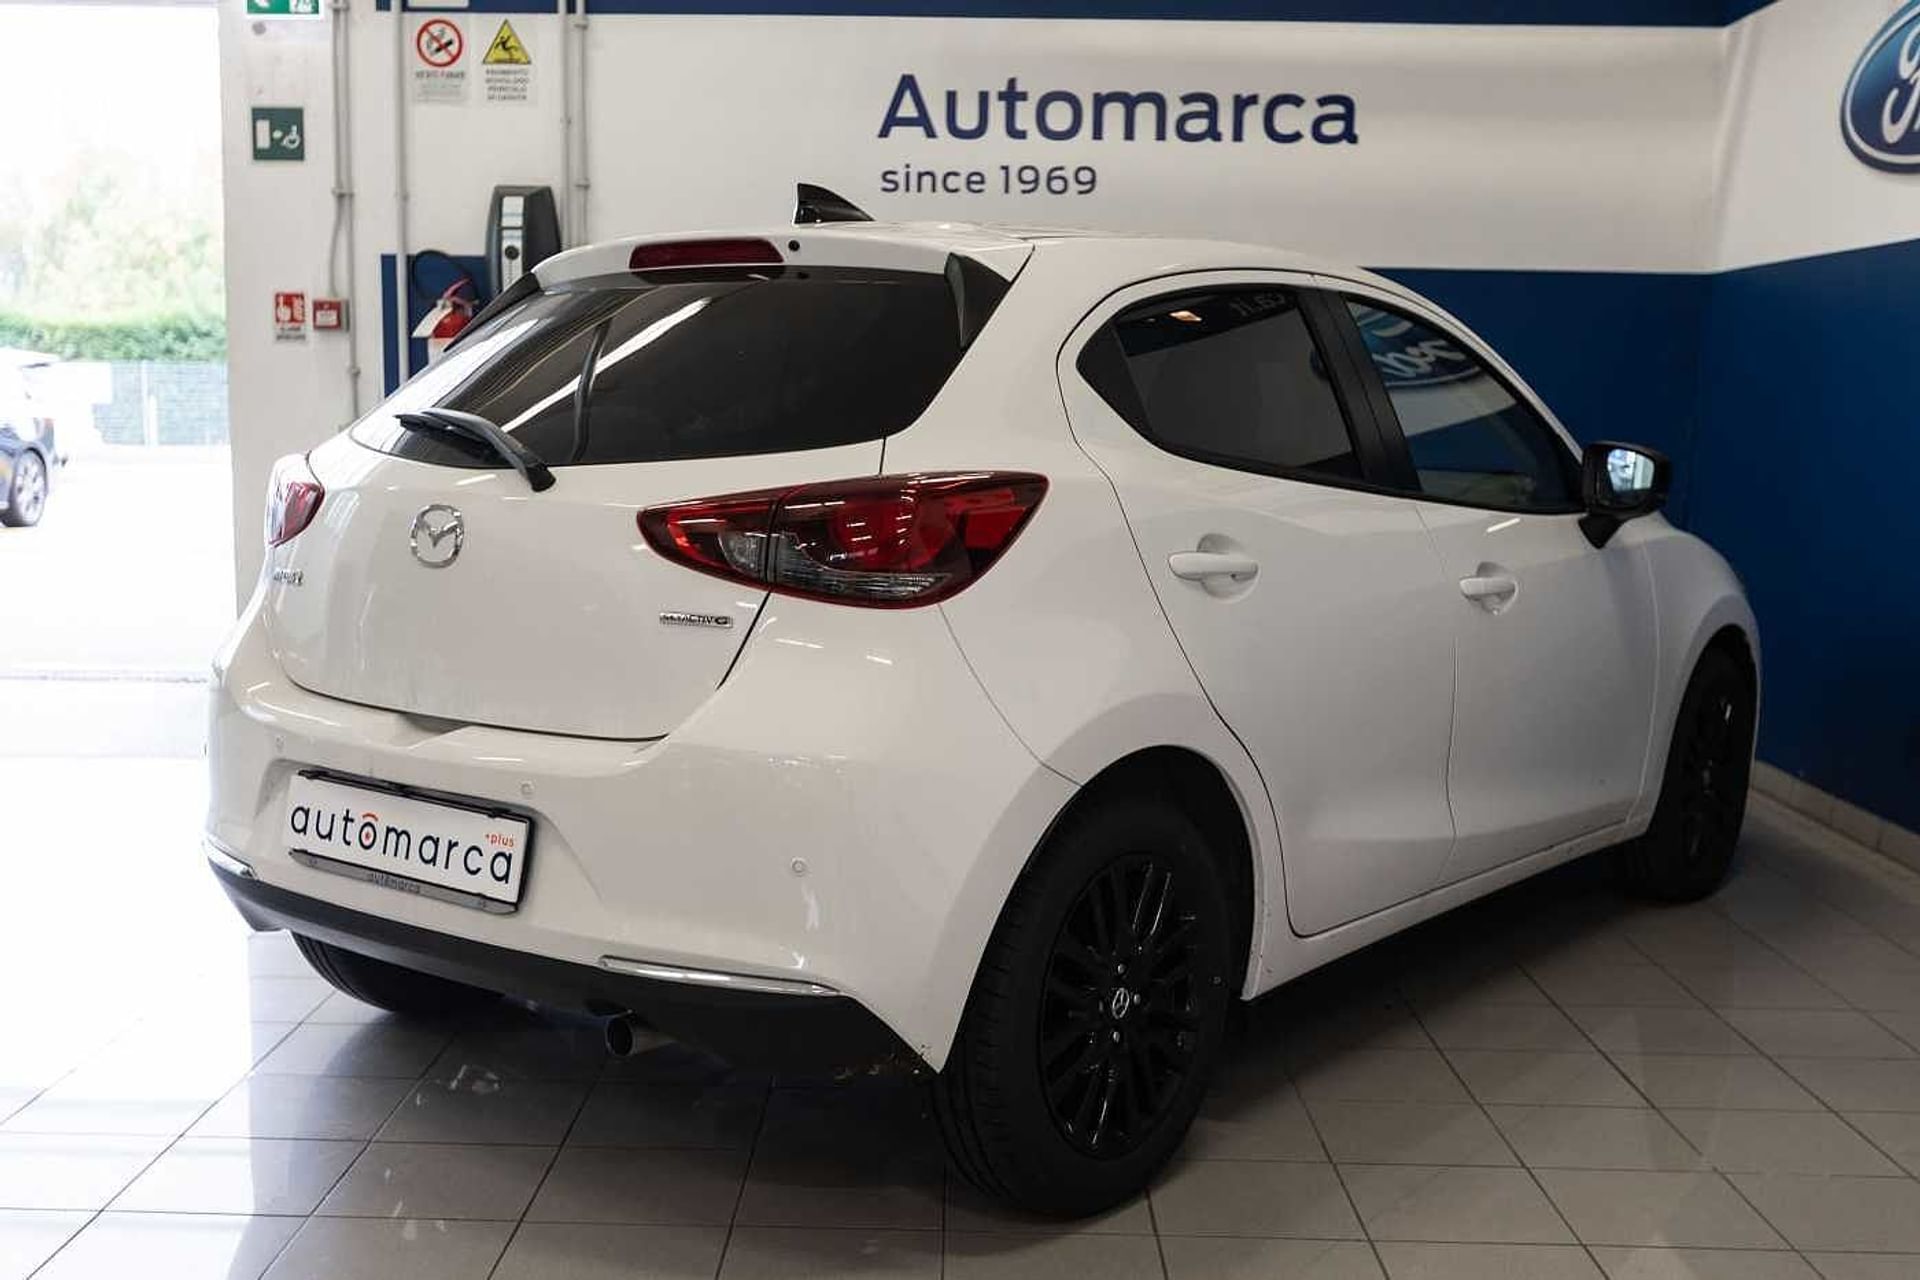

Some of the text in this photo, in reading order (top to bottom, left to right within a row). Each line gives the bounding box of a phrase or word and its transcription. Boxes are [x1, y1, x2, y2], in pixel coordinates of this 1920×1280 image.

[878, 74, 1359, 144] Automarca
[881, 164, 1097, 195] since 1969
